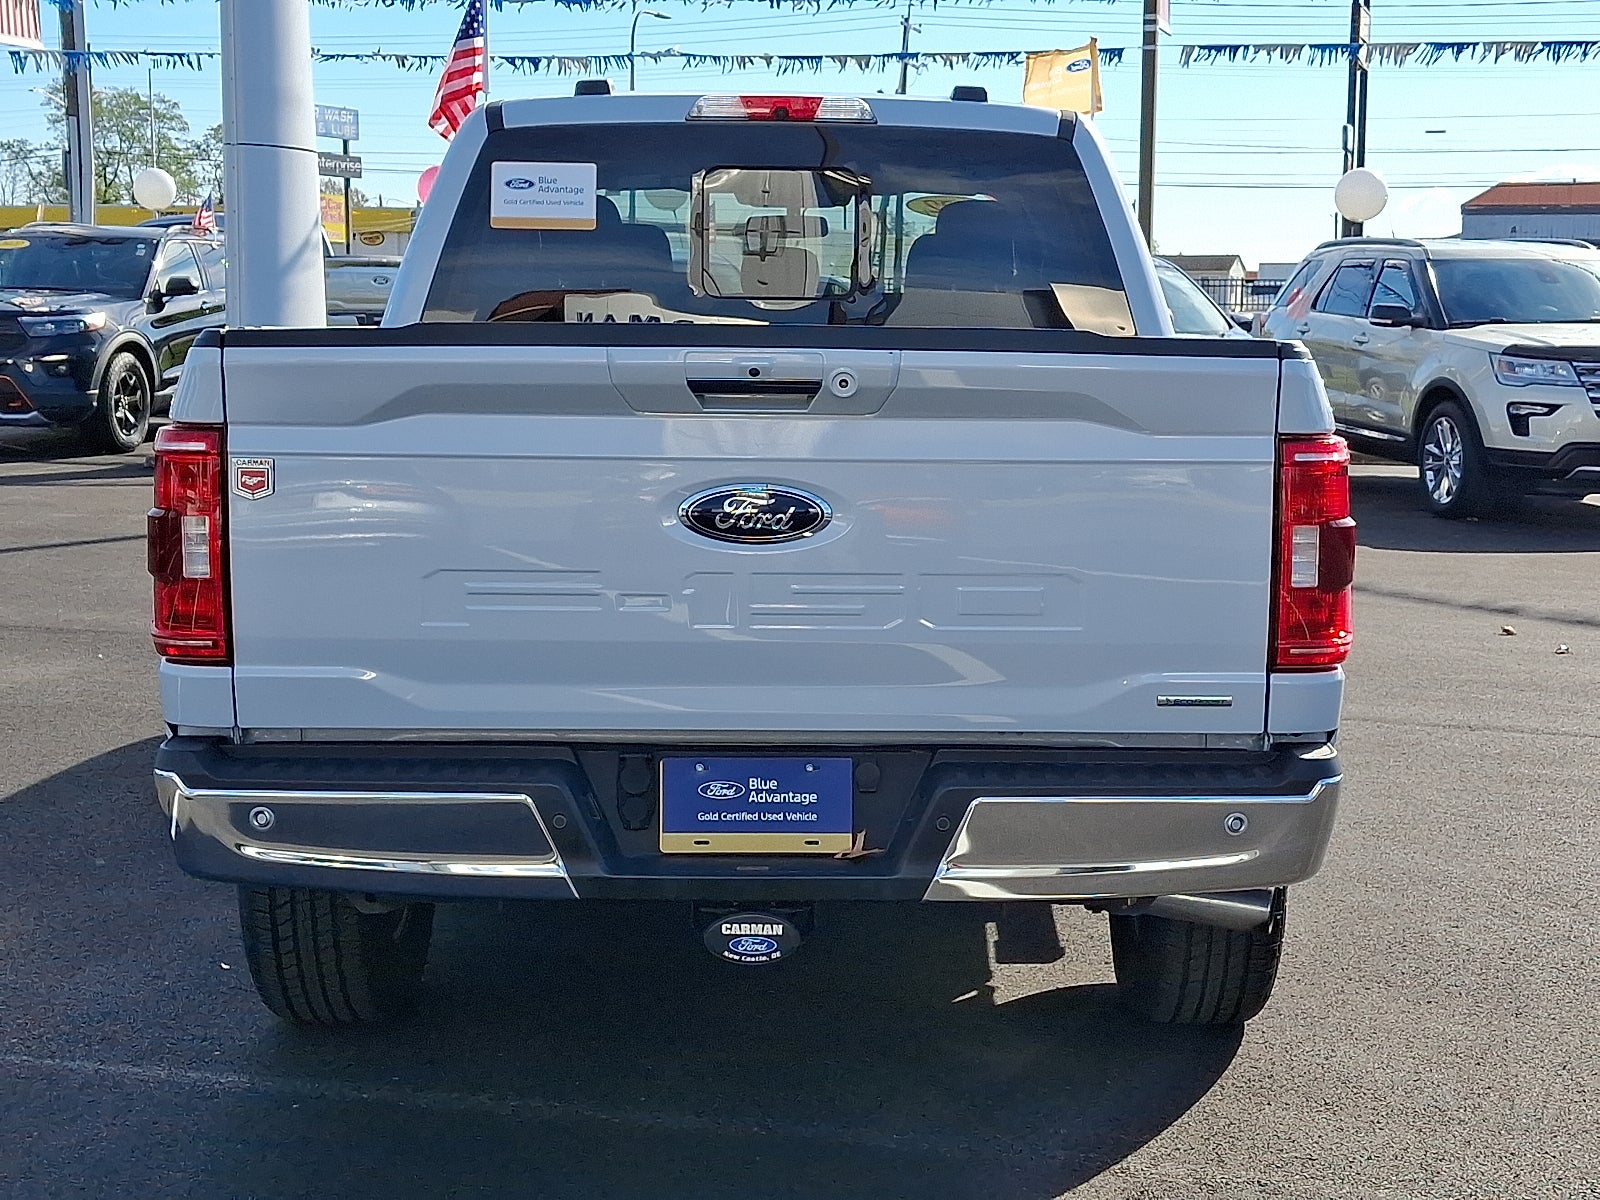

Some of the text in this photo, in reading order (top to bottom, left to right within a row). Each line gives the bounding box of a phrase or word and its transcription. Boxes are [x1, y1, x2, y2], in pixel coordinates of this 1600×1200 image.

[325, 108, 354, 124] WASH
[332, 124, 357, 138] LUBE
[538, 176, 558, 184] Blue
[538, 186, 585, 195] Advantage
[714, 496, 796, 530] Ford
[421, 569, 1083, 630] F-150
[706, 783, 737, 796] Ford
[749, 777, 778, 790] Blue
[749, 791, 818, 805] Advantage
[697, 811, 818, 821] Gold Certified Used Vehicle
[721, 923, 784, 936] CARMAN
[738, 939, 768, 951] Ford
[723, 950, 740, 960] New
